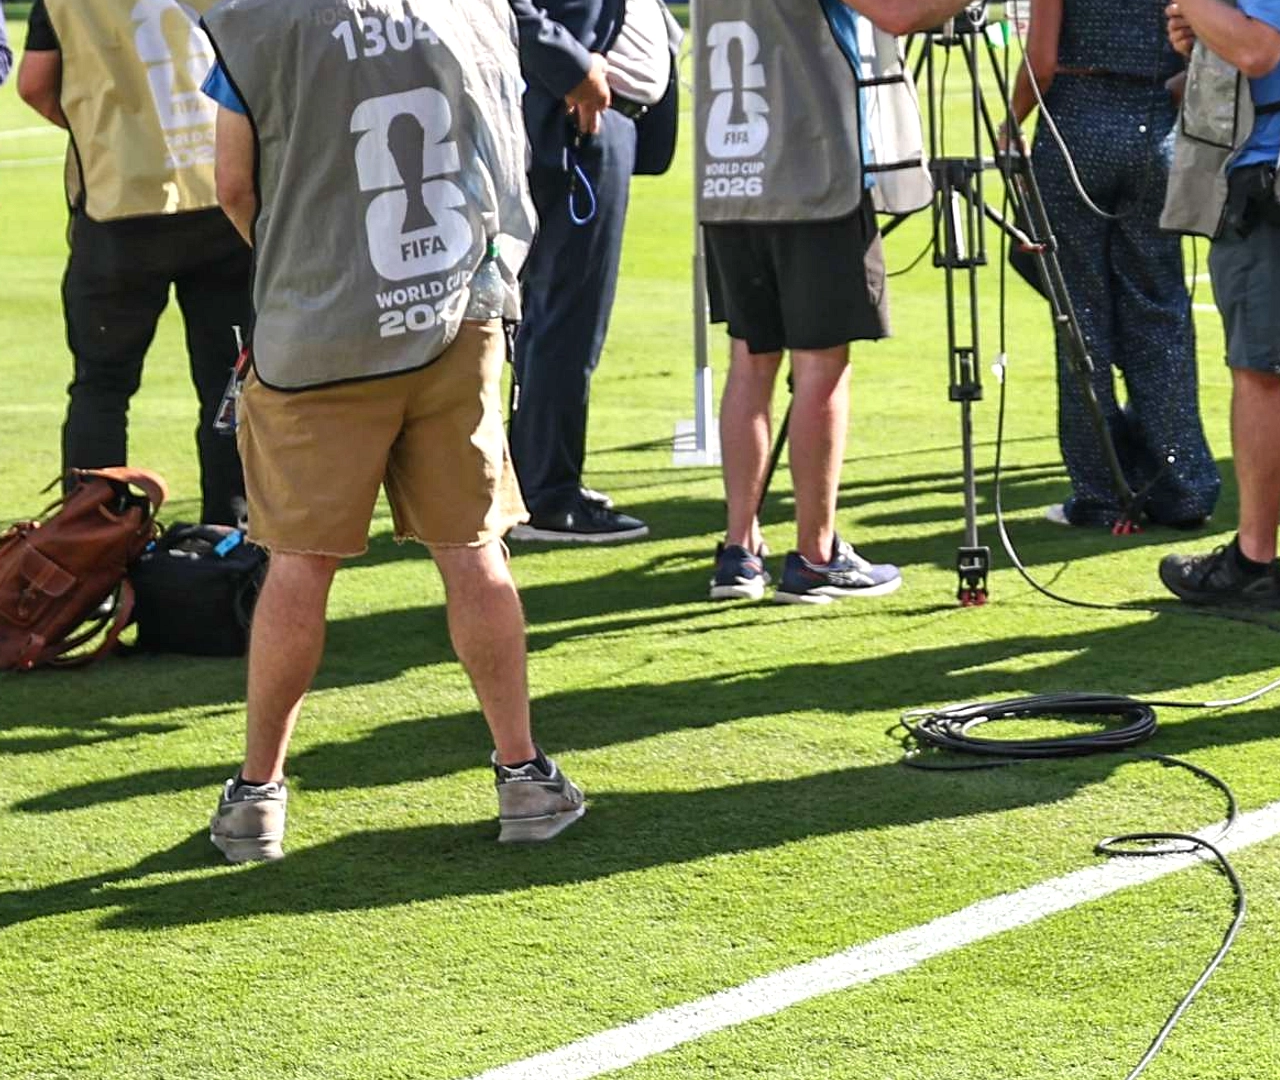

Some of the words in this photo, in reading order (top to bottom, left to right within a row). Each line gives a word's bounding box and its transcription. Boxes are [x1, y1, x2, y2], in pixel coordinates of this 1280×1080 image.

[331, 15, 440, 62] 1304
[724, 130, 749, 146] FIFA
[741, 161, 765, 174] CUP
[702, 176, 763, 199] 2026
[401, 235, 448, 262] FIFA
[375, 280, 444, 309] WORLD
